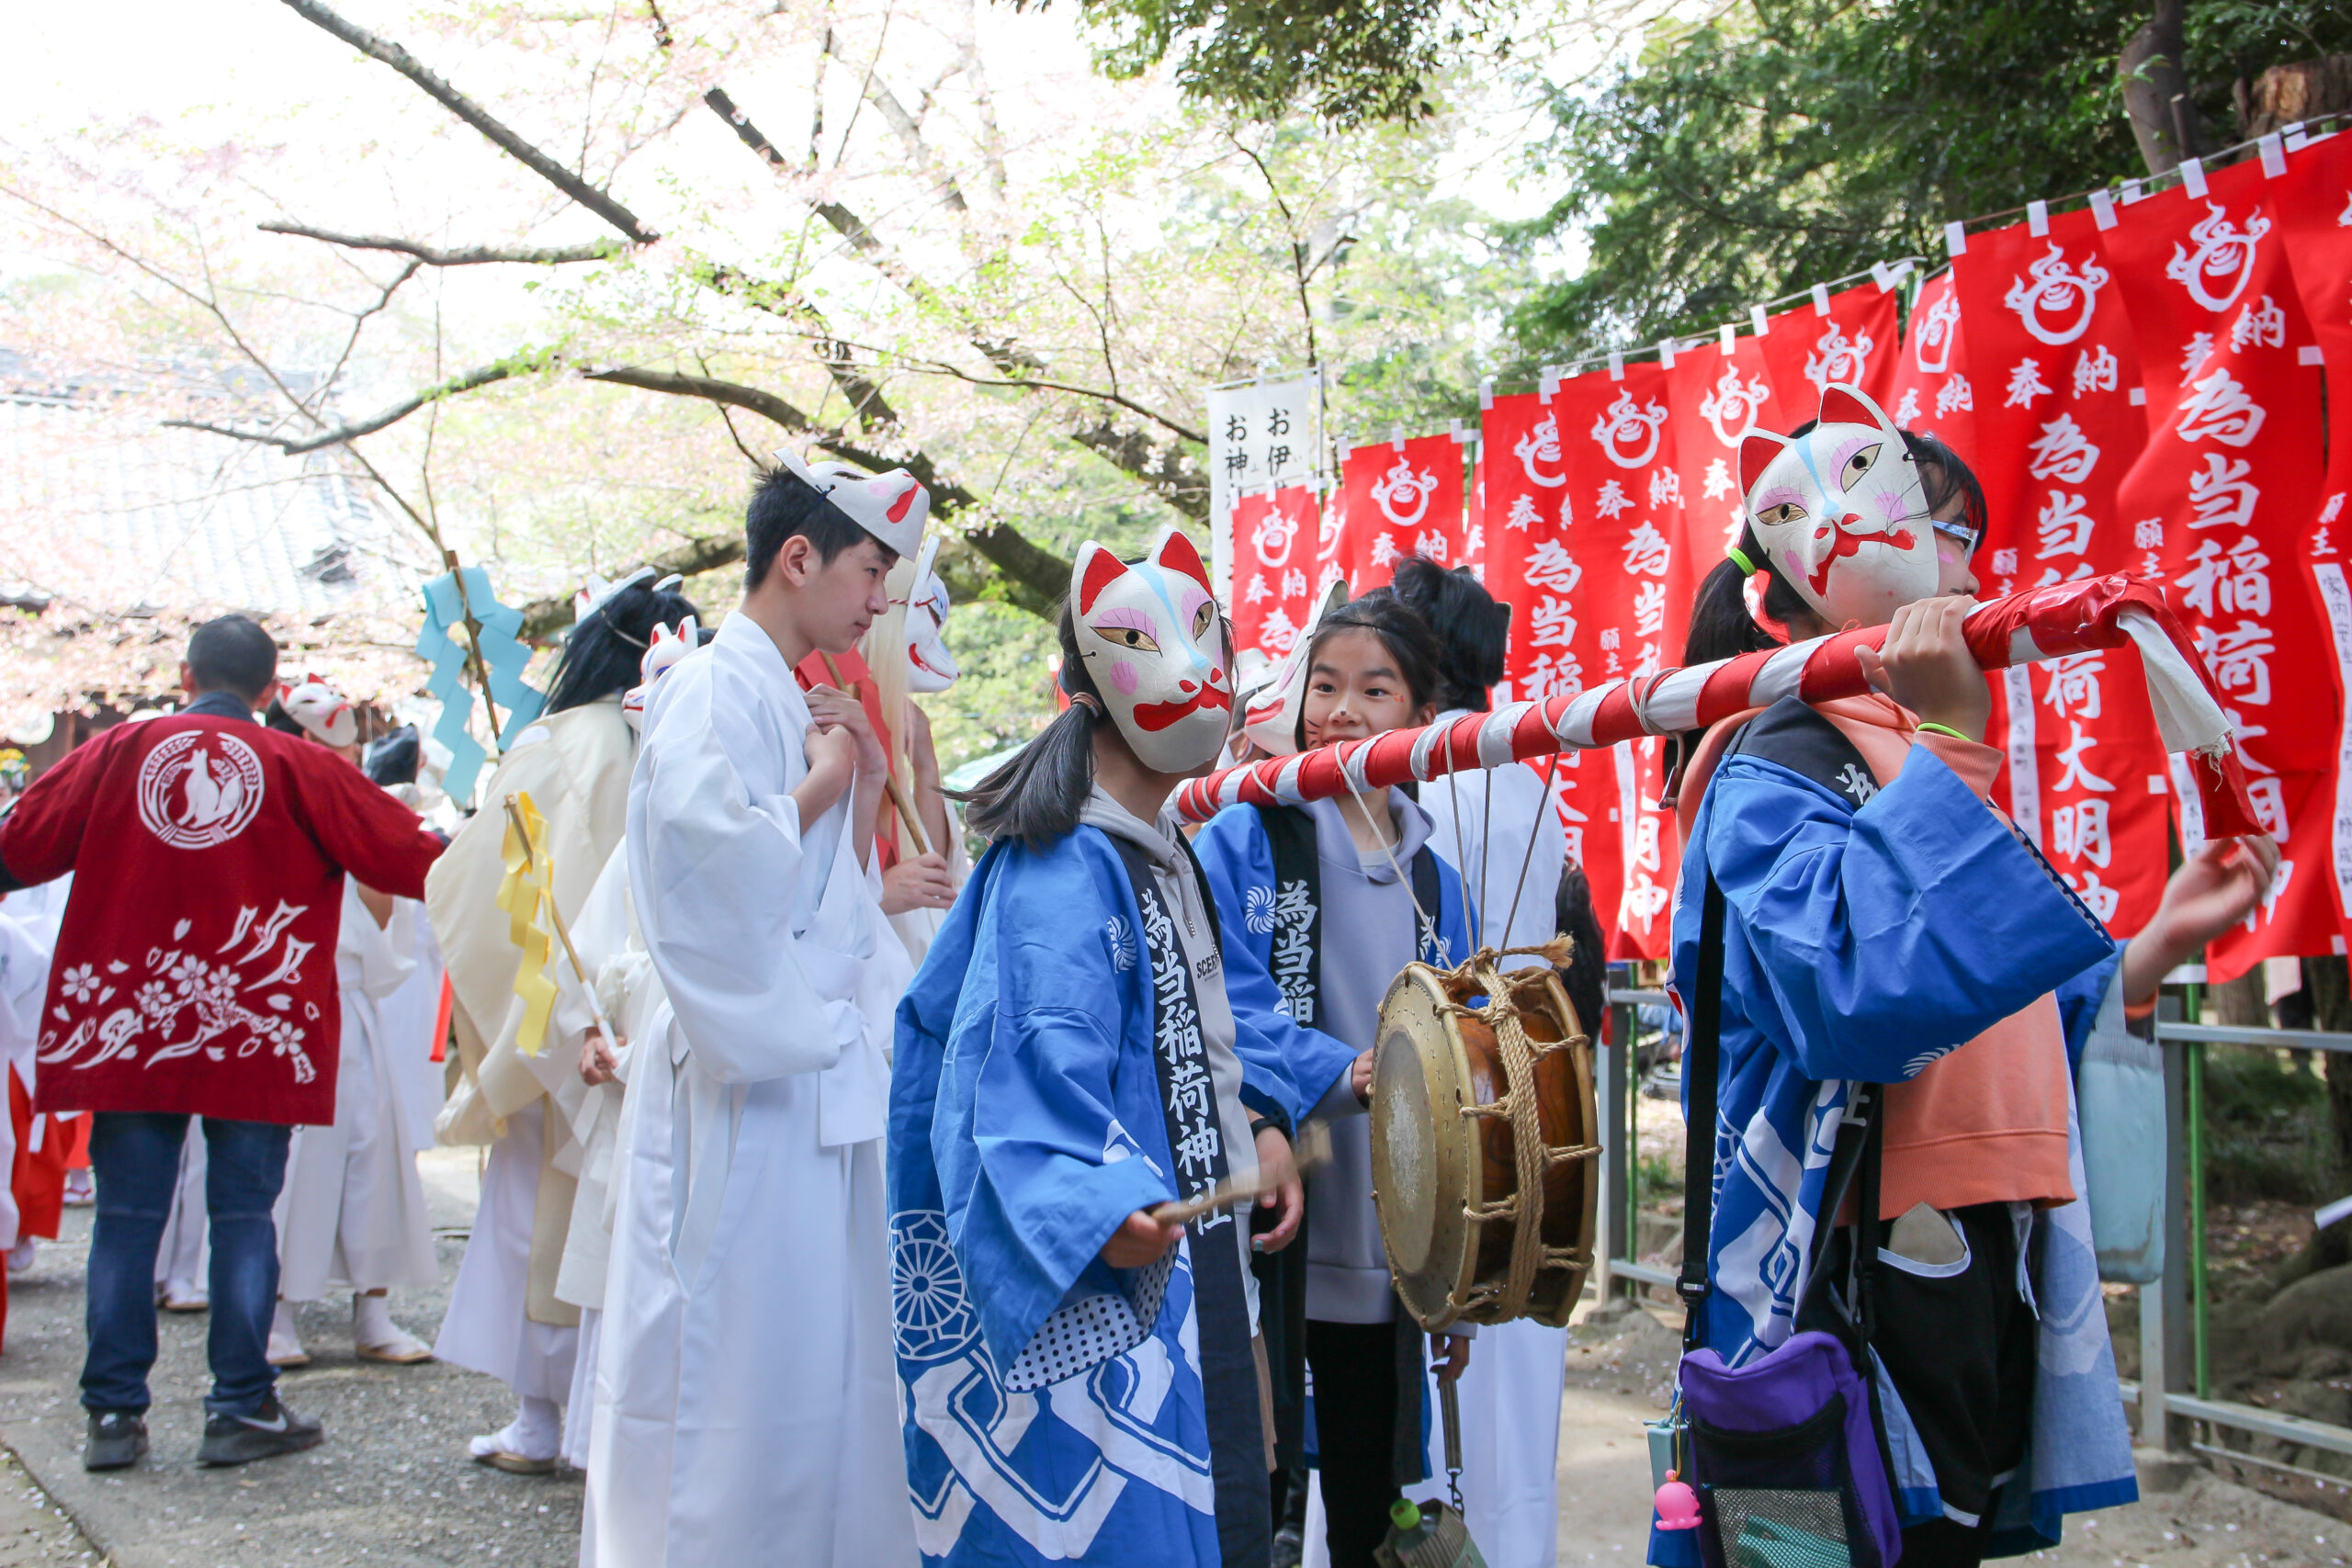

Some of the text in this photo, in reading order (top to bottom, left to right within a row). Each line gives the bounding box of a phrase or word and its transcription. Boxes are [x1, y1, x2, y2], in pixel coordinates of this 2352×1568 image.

[2177, 295, 2286, 389] 奉納
[1895, 373, 1973, 429] 奉納
[2004, 344, 2119, 412] 奉納
[1268, 408, 1291, 487] お伊
[1595, 466, 1680, 521] 奉納
[1370, 527, 1449, 567] 奉納
[1991, 547, 2018, 598] 願主
[2134, 516, 2165, 580] 願主
[1245, 567, 1307, 605] 奉納
[1600, 626, 1623, 674] 願主
[1274, 879, 1318, 1029] 為当稲
[1139, 887, 1233, 1237] 為当稲荷神社
